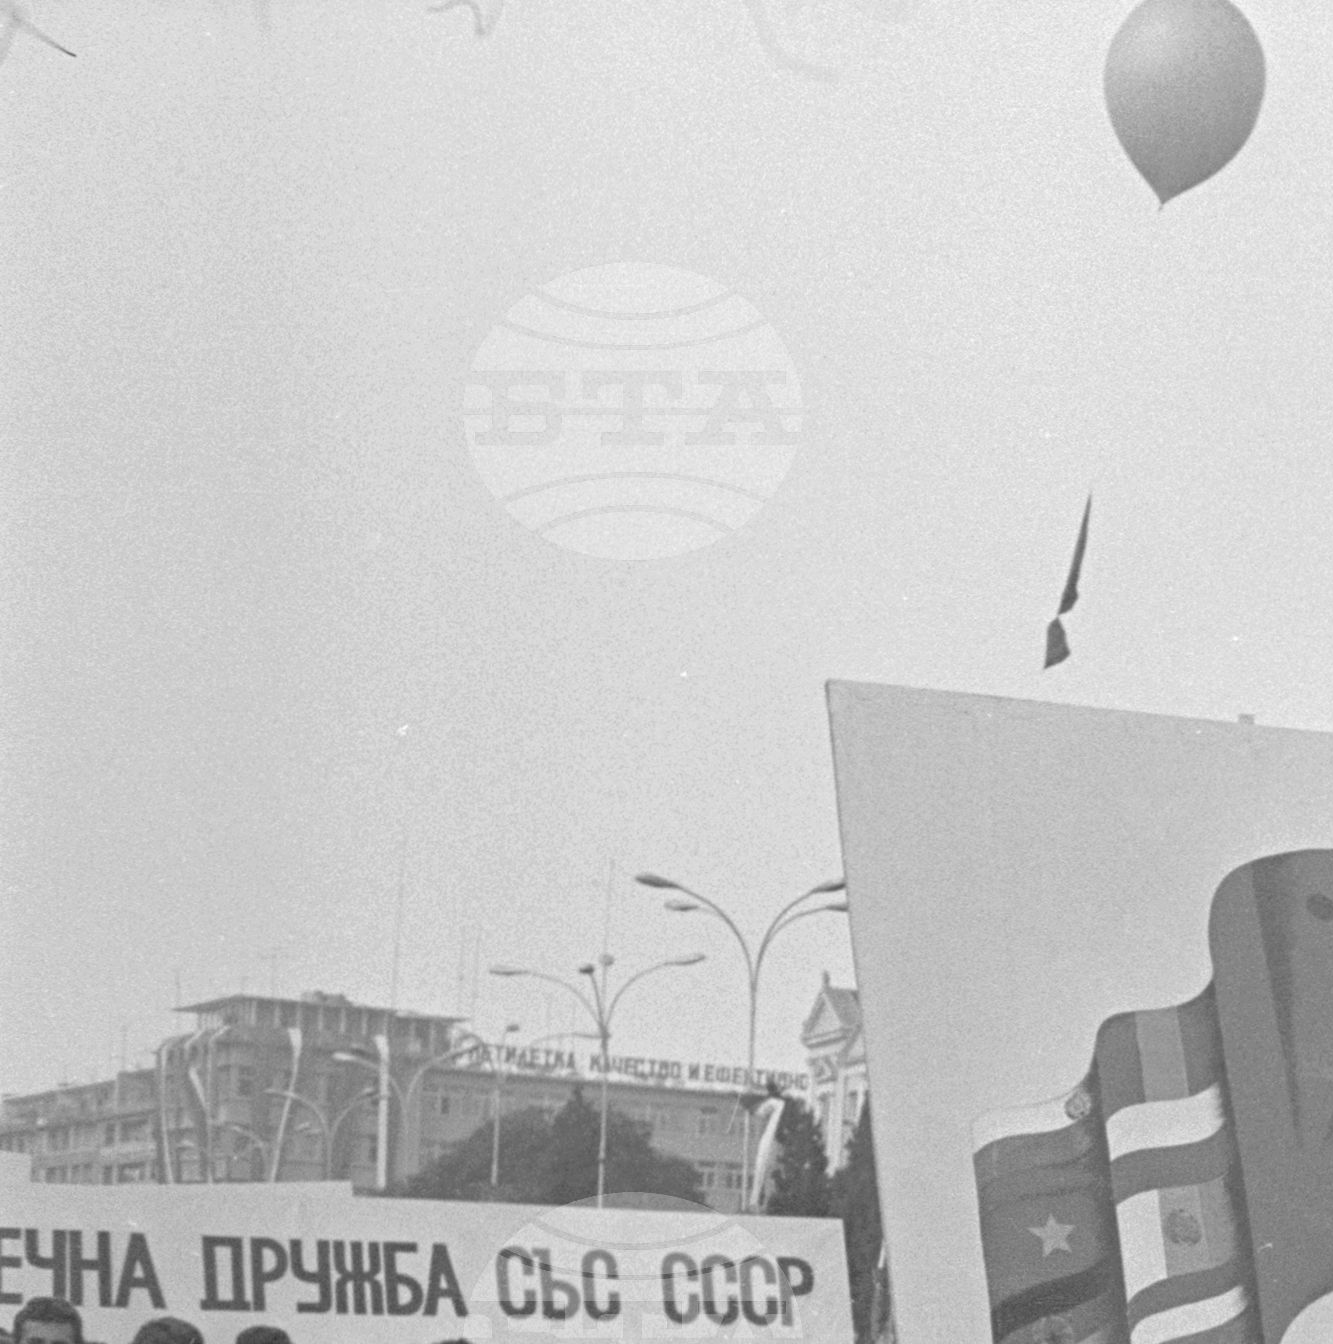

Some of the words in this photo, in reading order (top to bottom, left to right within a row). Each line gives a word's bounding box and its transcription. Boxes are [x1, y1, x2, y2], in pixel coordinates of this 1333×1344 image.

[200, 1235, 469, 1317] ДРУЖБА
[496, 1246, 621, 1321] СЪС
[661, 1252, 815, 1327] СССР
